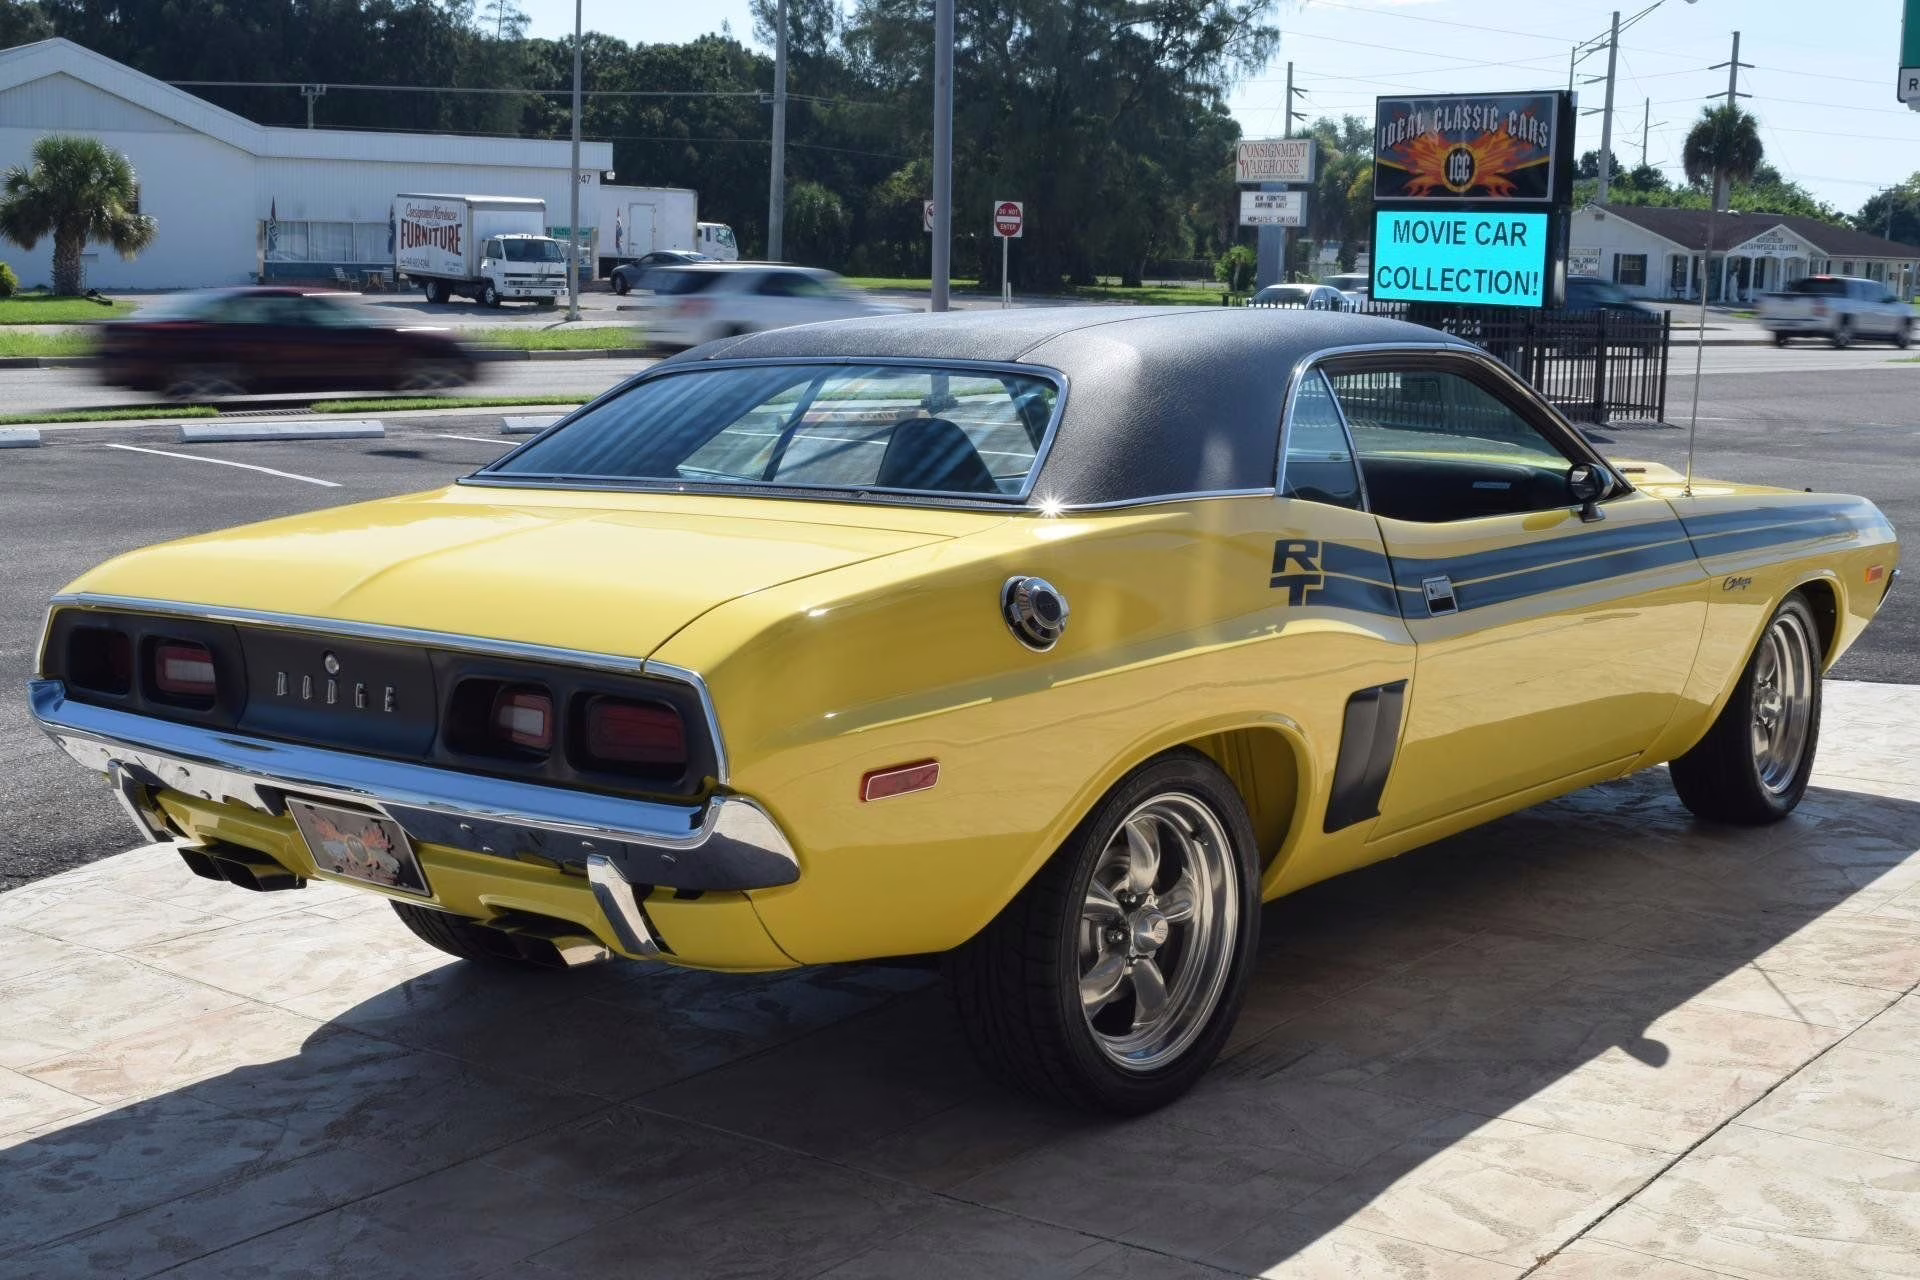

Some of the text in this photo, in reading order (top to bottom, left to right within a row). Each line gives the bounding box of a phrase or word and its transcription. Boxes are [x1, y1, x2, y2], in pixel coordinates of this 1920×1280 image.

[1381, 104, 1549, 150] IDEAL CLASSIC CARS
[1238, 143, 1308, 163] CONSIGNMENT
[1449, 153, 1470, 182] ICC
[1240, 160, 1300, 178] WAREHOUSE
[401, 218, 462, 255] FURNITURE
[1393, 219, 1527, 247] MOVIE CAR
[1377, 265, 1539, 296] COLLECTION!
[276, 671, 393, 713] DODGE
